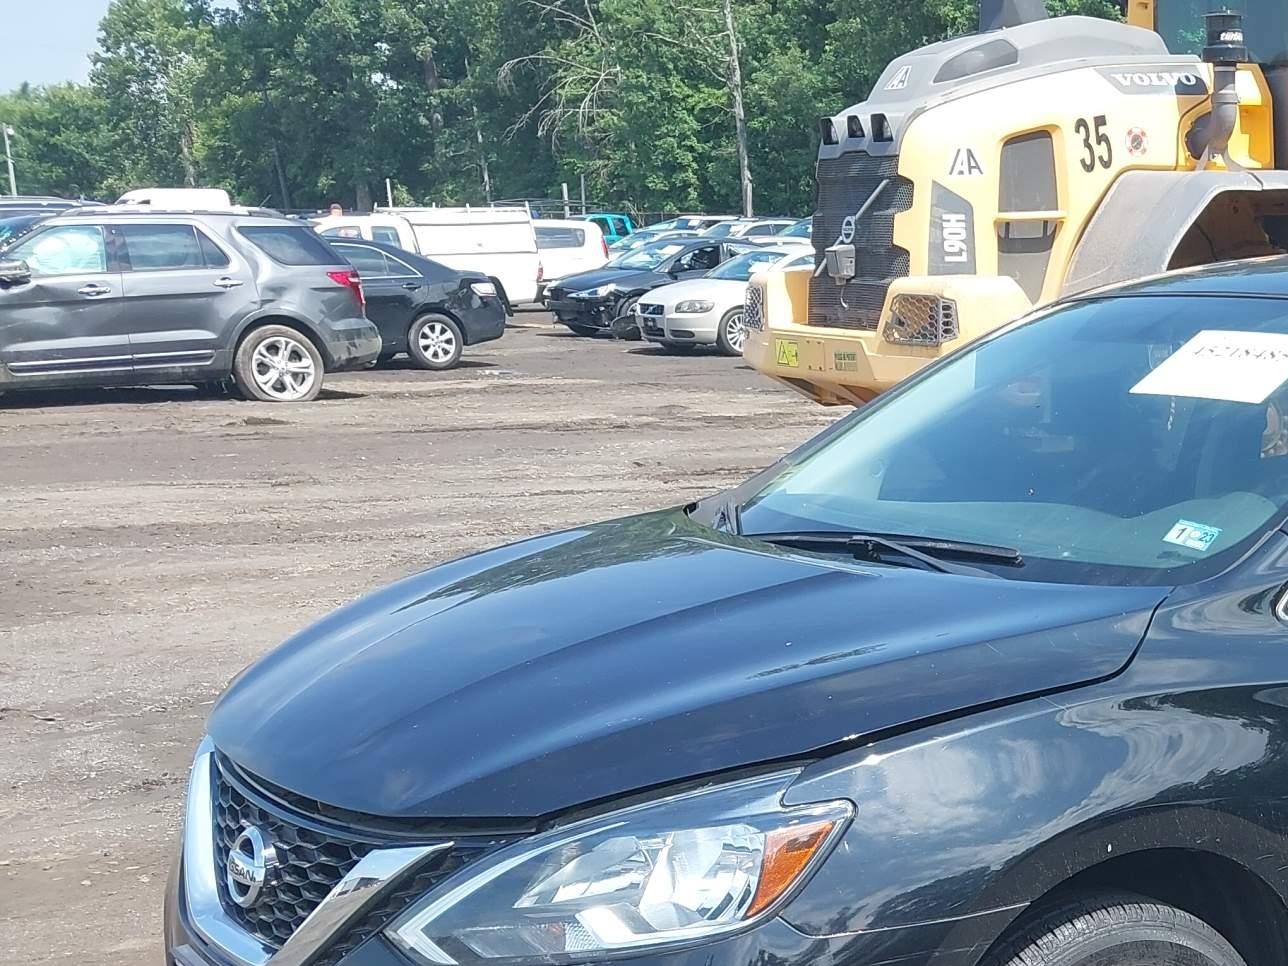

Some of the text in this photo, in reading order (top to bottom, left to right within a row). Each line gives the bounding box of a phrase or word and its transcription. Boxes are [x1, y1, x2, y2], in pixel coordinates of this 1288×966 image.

[1110, 72, 1197, 86] VOLVO
[1074, 114, 1113, 174] 35
[942, 213, 969, 263] L90H
